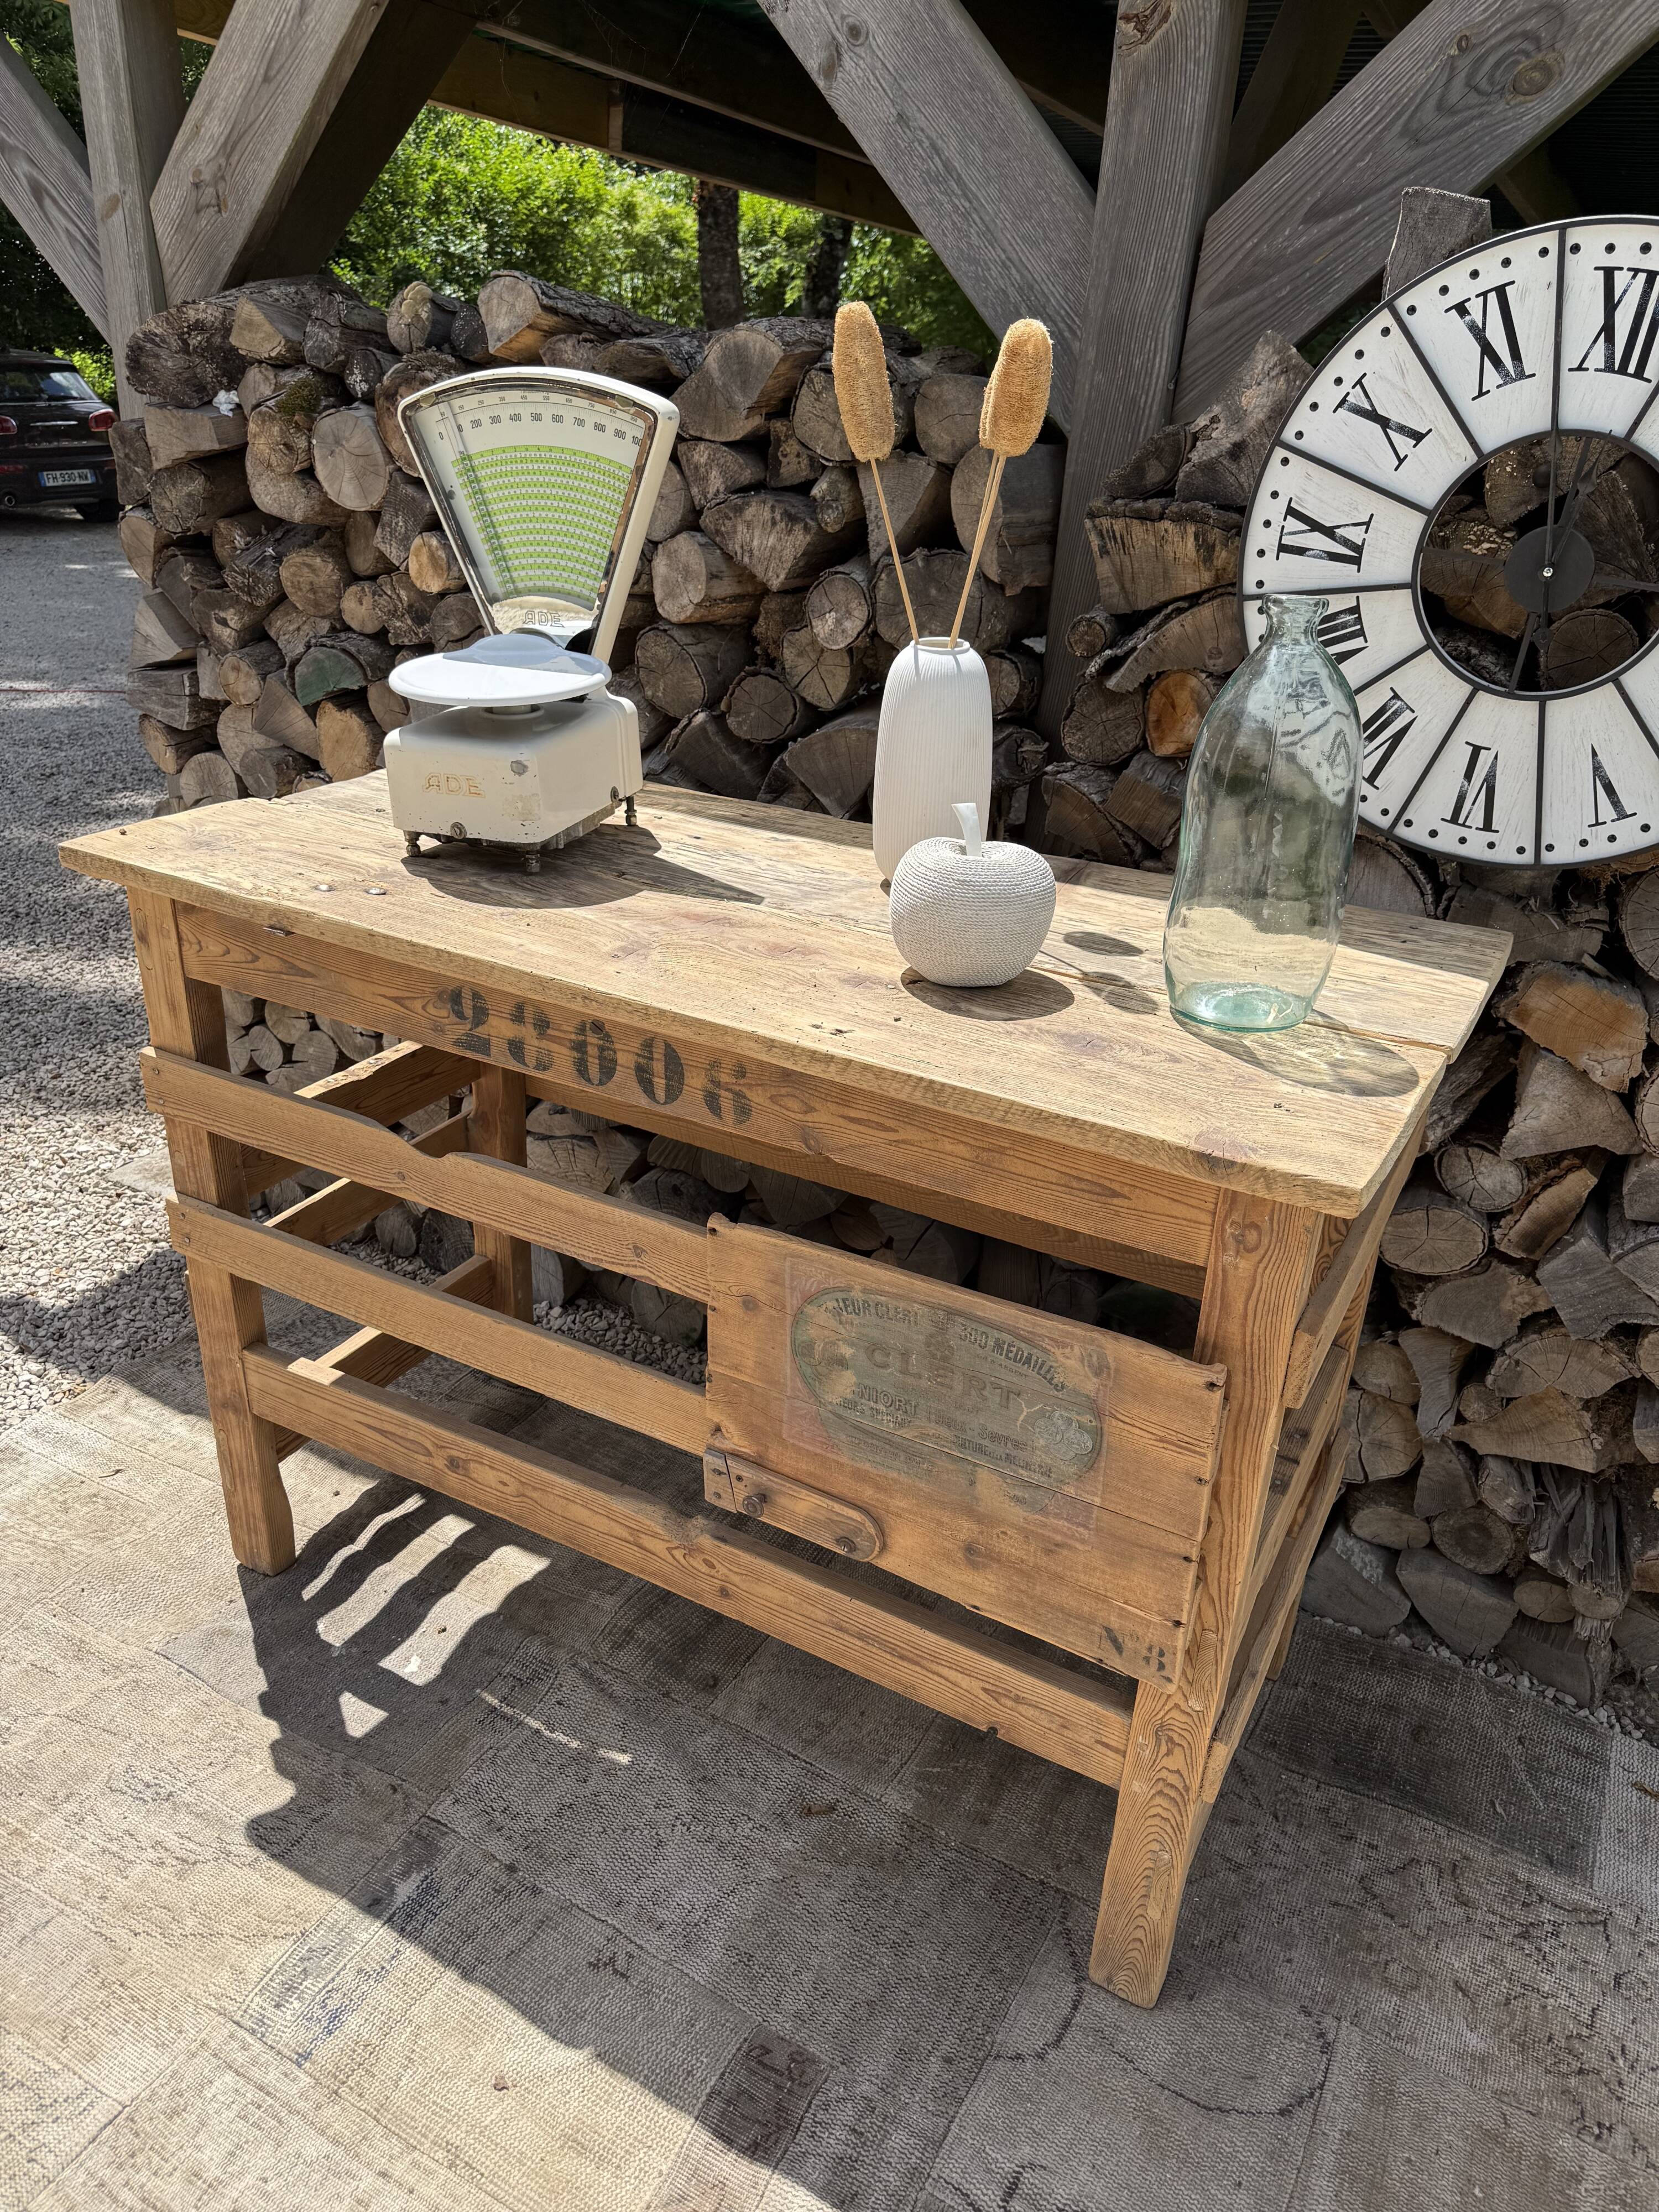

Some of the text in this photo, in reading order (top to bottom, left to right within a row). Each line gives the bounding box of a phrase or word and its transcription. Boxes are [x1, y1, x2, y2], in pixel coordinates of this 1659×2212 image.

[1444, 279, 1536, 401] XI
[1567, 265, 1659, 384] XII
[439, 431, 444, 440] 0
[470, 418, 482, 429] 200
[489, 415, 502, 425] 300
[509, 413, 521, 422] 400
[530, 413, 542, 422] 500
[552, 414, 564, 424] 600
[573, 416, 586, 427] 700
[593, 422, 606, 433] 800
[613, 428, 627, 440] 900
[1332, 372, 1432, 471] X
[1275, 497, 1373, 573] IX
[523, 610, 565, 628] ADE
[422, 773, 486, 798] ADE
[1440, 740, 1500, 833] VI
[1587, 744, 1637, 828] V
[858, 1383, 920, 1417] NIORT
